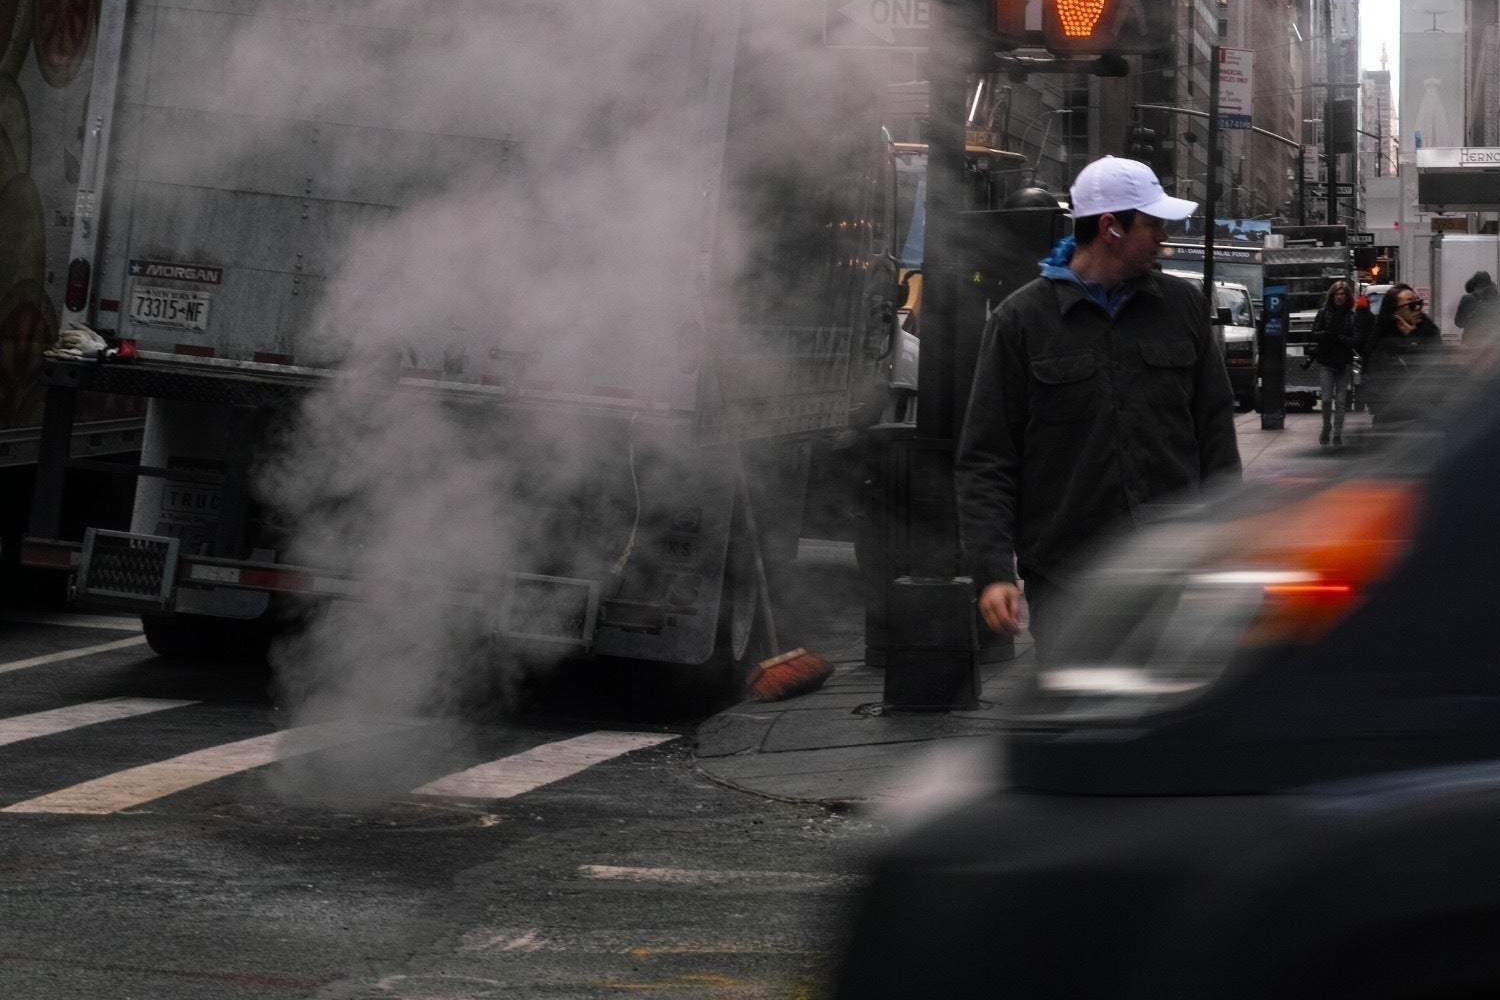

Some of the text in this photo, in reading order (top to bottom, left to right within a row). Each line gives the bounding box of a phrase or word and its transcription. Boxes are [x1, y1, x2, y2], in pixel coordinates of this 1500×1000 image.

[1232, 251, 1250, 259] FOOD
[145, 263, 219, 282] MORGAN
[1269, 296, 1280, 310] P
[170, 491, 221, 509] TRUC
